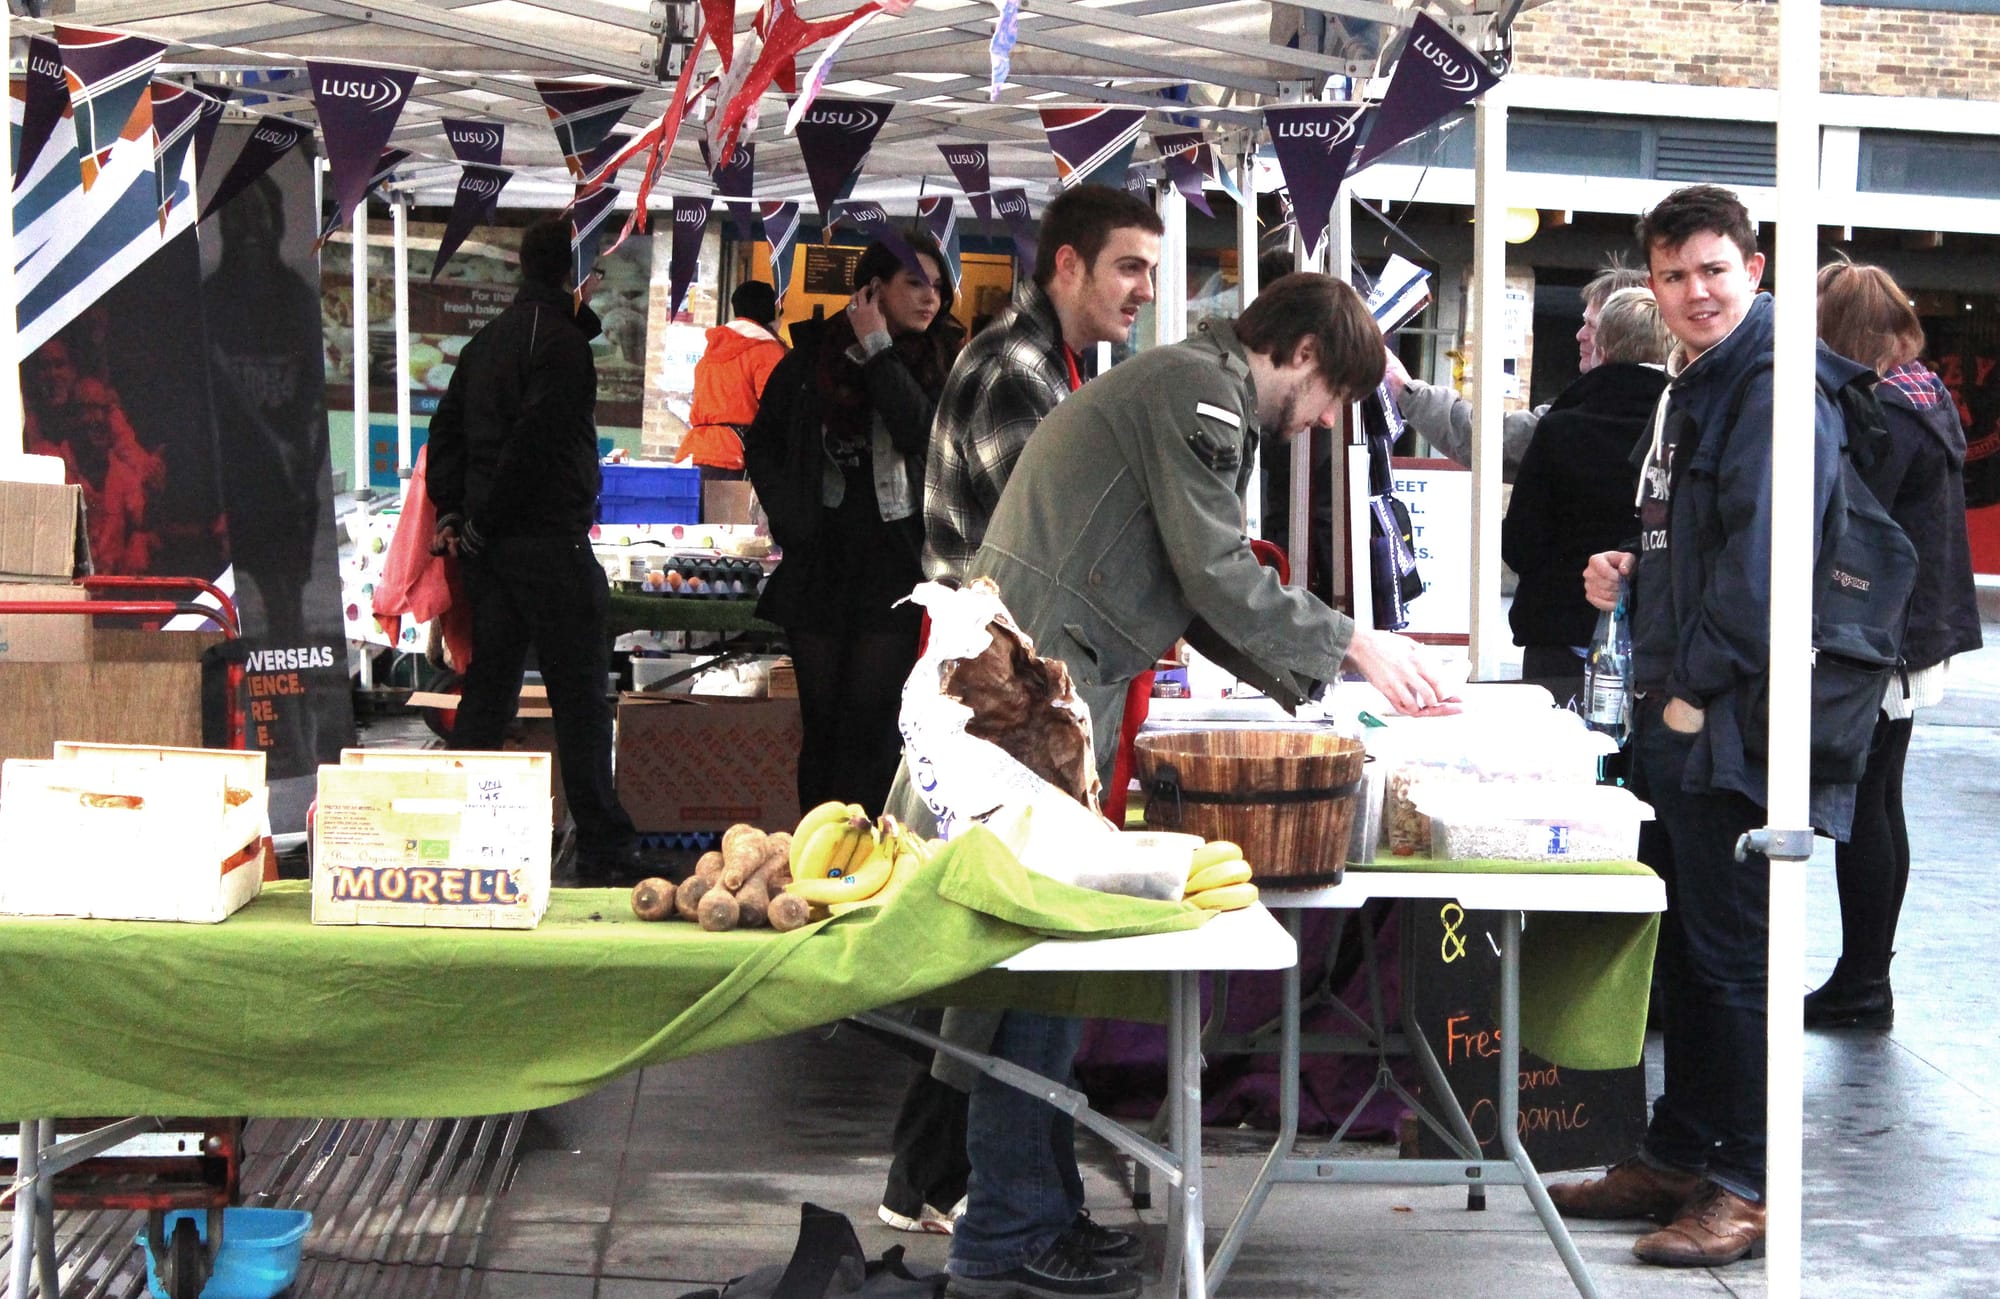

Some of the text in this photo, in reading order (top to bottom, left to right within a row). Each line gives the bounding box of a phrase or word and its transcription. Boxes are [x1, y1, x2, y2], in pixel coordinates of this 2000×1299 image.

[1412, 34, 1461, 76] LUSU
[31, 56, 65, 80] LUSU
[321, 79, 376, 100] LUSU
[254, 127, 286, 145] LUSU
[453, 131, 485, 144] LUSU
[1278, 122, 1331, 138] LUSU
[949, 153, 974, 165] LUSU
[460, 177, 489, 193] LUSU
[1000, 200, 1020, 214] LUSU
[676, 209, 699, 223] LUSU
[853, 210, 878, 222] LUSU
[472, 291, 491, 301] For
[444, 302, 473, 313] fresh
[337, 868, 517, 904] MORELL
[1440, 903, 1467, 963] &
[1518, 1064, 1560, 1091] and
[1469, 1099, 1591, 1146] Oganic
